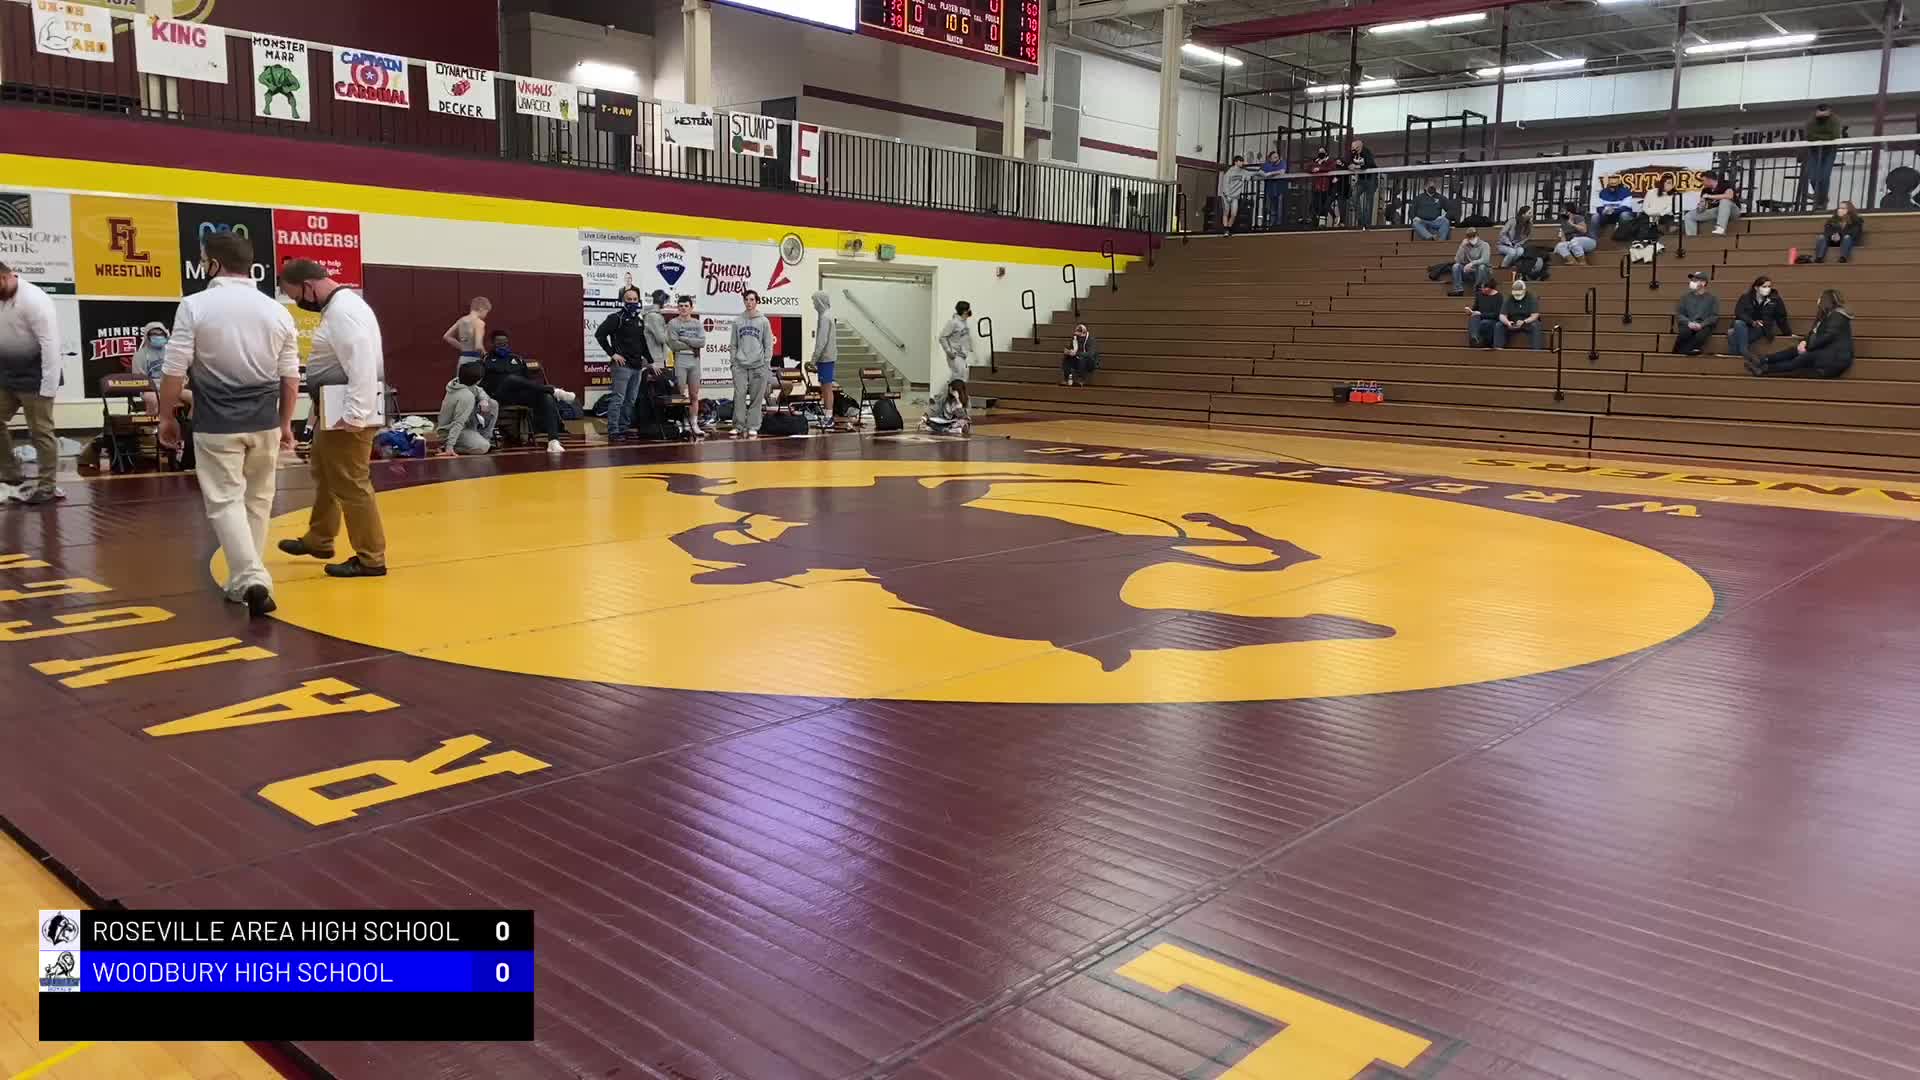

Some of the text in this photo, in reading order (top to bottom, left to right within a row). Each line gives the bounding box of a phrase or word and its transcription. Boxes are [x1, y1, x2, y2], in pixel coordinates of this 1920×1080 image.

[914, 4, 922, 23] 0
[152, 21, 207, 48] KING
[908, 25, 925, 36] SCORE
[990, 25, 998, 41] 0
[253, 36, 305, 53] MONSTER
[984, 43, 999, 54] SCORE
[265, 50, 295, 63] MARR
[341, 51, 403, 73] CAPTAIN
[436, 62, 487, 82] DYNAMITE
[335, 81, 409, 106] CARDINAL
[518, 79, 553, 97] VICIOUS
[439, 100, 484, 118] DECKER
[601, 106, 634, 118] T-RAW
[732, 113, 775, 141] STUMP
[798, 123, 819, 184] E
[307, 215, 329, 230] GO
[277, 230, 359, 249] RANGERS!
[592, 251, 638, 263] CARNEY
[658, 251, 683, 261] RE/MAX
[95, 263, 162, 279] WRESTLING
[700, 256, 752, 279] Famous
[705, 274, 748, 297] Dave's
[773, 296, 800, 306] SPORTS
